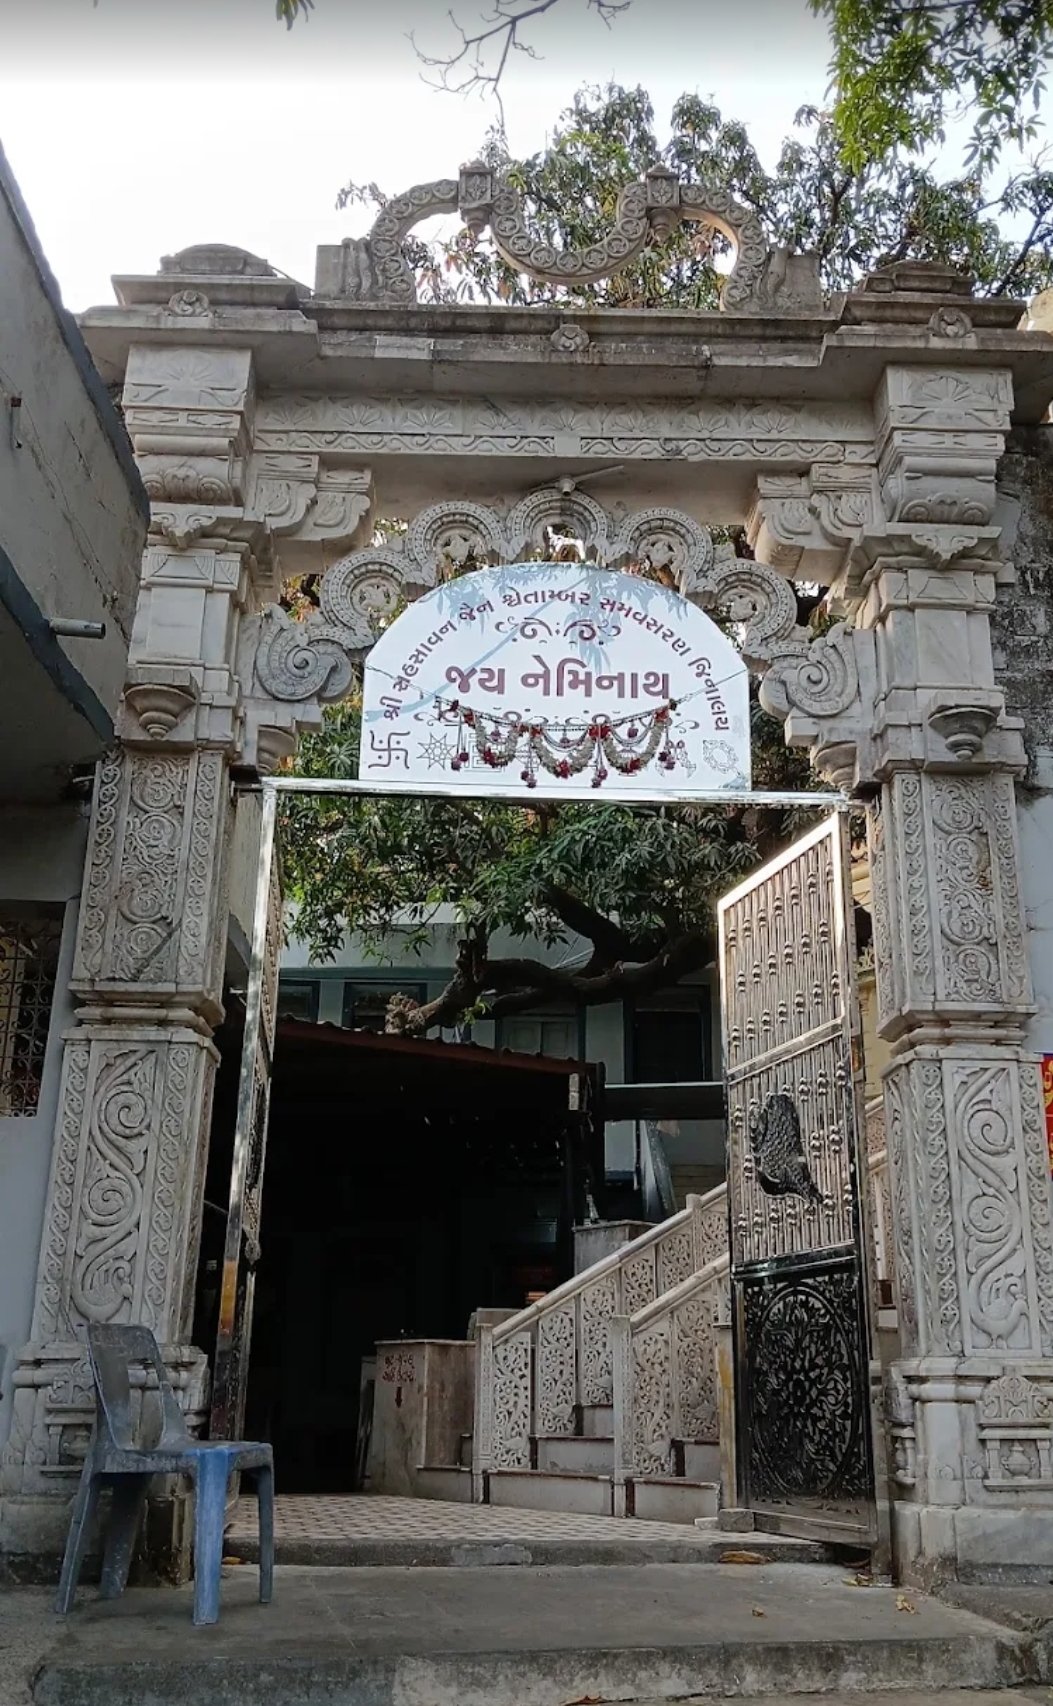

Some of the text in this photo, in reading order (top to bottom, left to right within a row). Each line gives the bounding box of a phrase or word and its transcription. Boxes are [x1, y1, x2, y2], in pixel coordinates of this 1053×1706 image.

[380, 696, 403, 721] શ્રી
[600, 597, 692, 656] સમવસરણ
[688, 656, 730, 731] જિનાલય
[445, 654, 670, 700] જય નેમિનાથ
